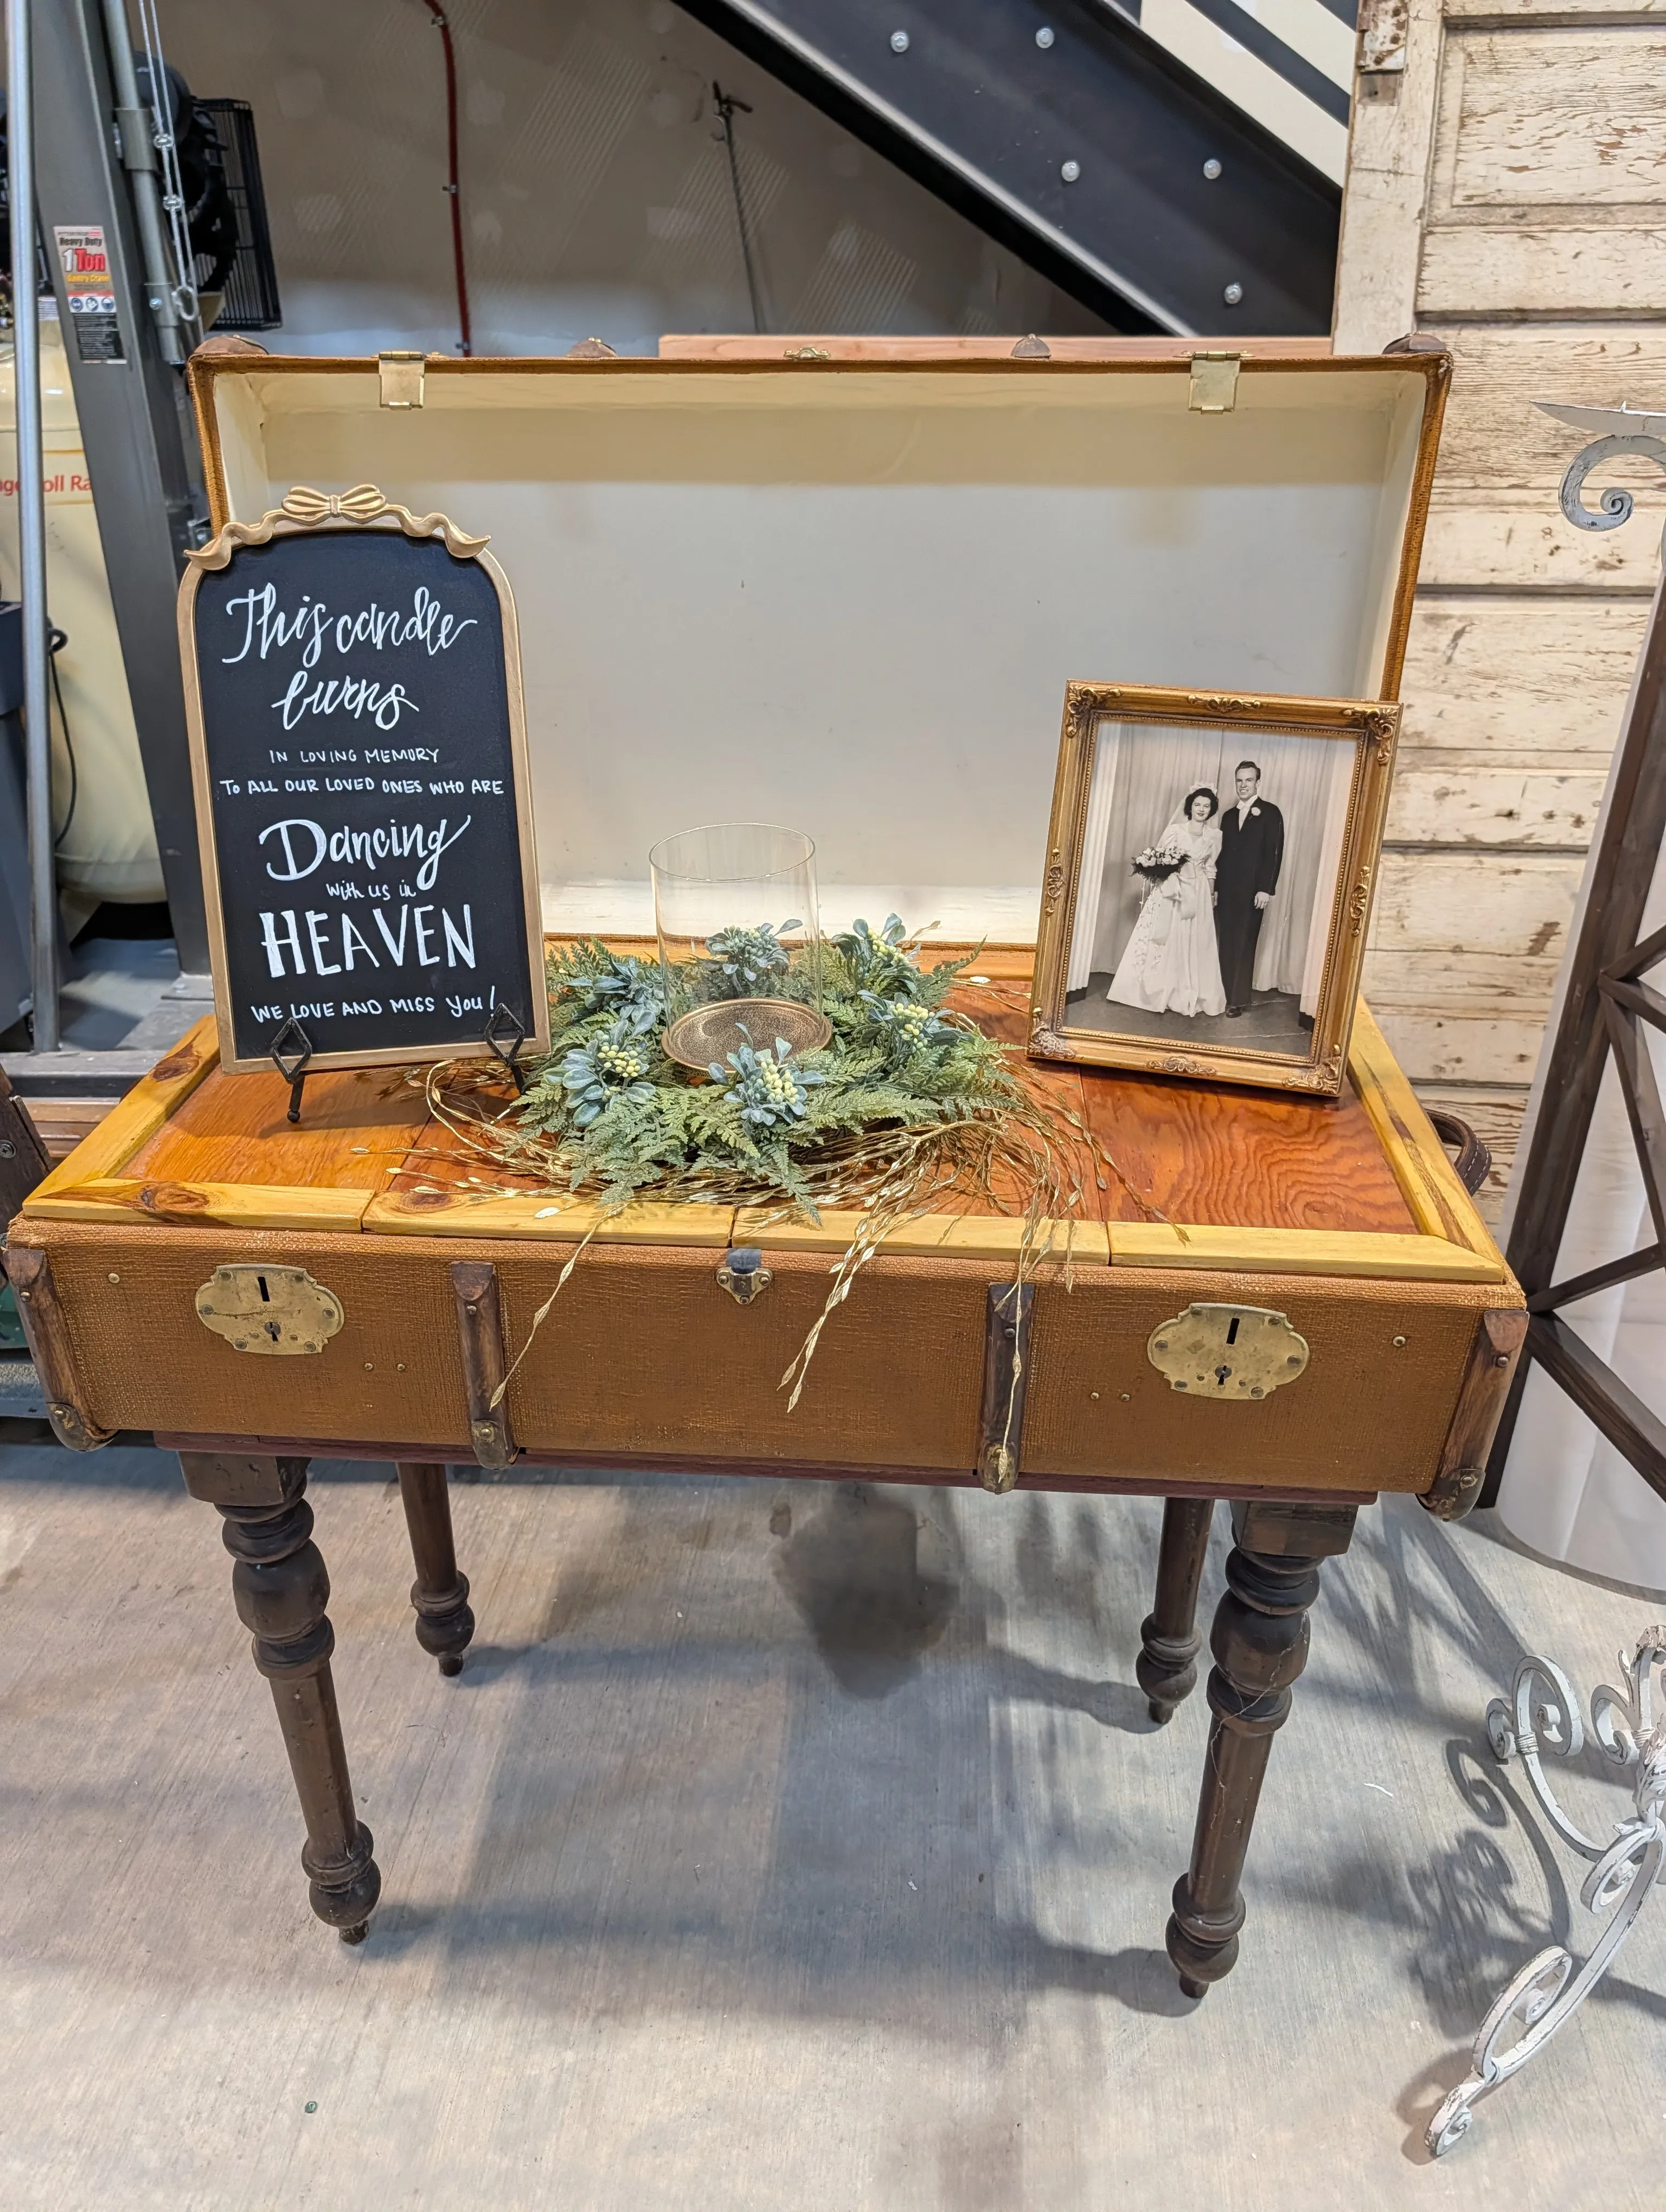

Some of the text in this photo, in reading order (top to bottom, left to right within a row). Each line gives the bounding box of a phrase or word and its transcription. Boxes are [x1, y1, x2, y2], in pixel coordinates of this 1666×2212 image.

[85, 237, 102, 247] Duty
[62, 248, 105, 272] 1 Ton
[222, 582, 478, 668] This candle
[271, 670, 420, 731] burns
[269, 747, 440, 764] IN LOVING MEMORY
[247, 780, 279, 796] ALL
[285, 779, 319, 793] OUR
[325, 777, 375, 792] LOVED
[382, 779, 424, 794] ONES
[429, 779, 465, 795] WHO
[471, 779, 504, 795] ARE
[258, 814, 471, 891] Dancing
[325, 879, 417, 901] with us in
[259, 904, 476, 978] HEAVEN
[251, 1005, 284, 1023] WE
[290, 1001, 336, 1019] LOVE
[342, 999, 382, 1017] AND
[389, 996, 435, 1014] MISS
